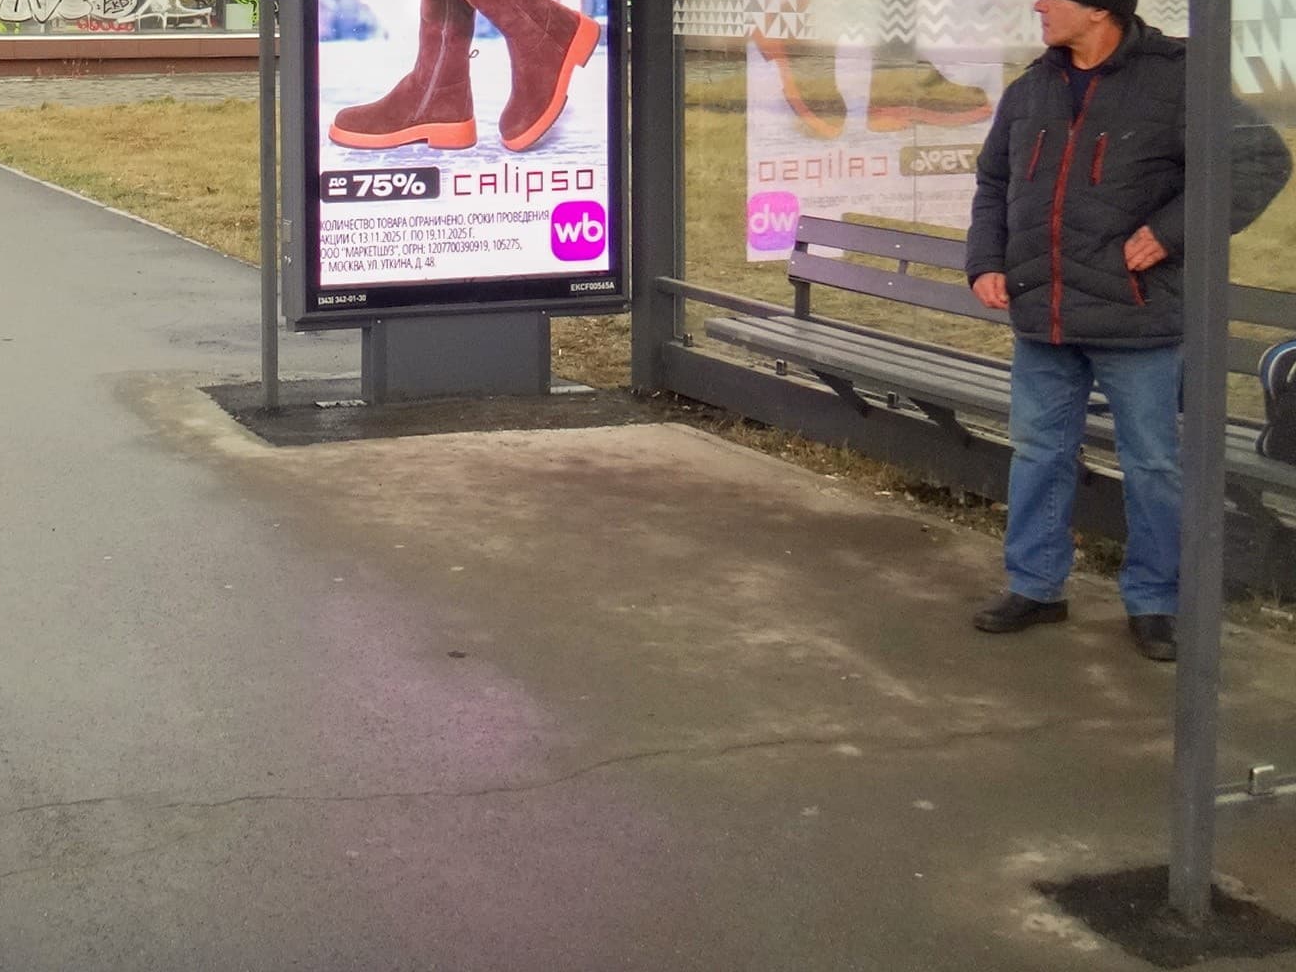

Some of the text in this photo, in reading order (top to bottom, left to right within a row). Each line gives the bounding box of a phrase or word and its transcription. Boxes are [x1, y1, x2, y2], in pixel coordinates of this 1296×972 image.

[320, 218, 375, 232] КОЛИЧЕСТВО
[377, 216, 408, 229] ТОВАРА
[467, 212, 495, 225] СРОКИ
[497, 210, 550, 224] ПРОВЕДЕНИЯ
[553, 212, 604, 244] wb
[320, 233, 350, 247] АКЦИИ
[410, 229, 424, 242] ПО
[426, 227, 468, 242] 19.11.2025
